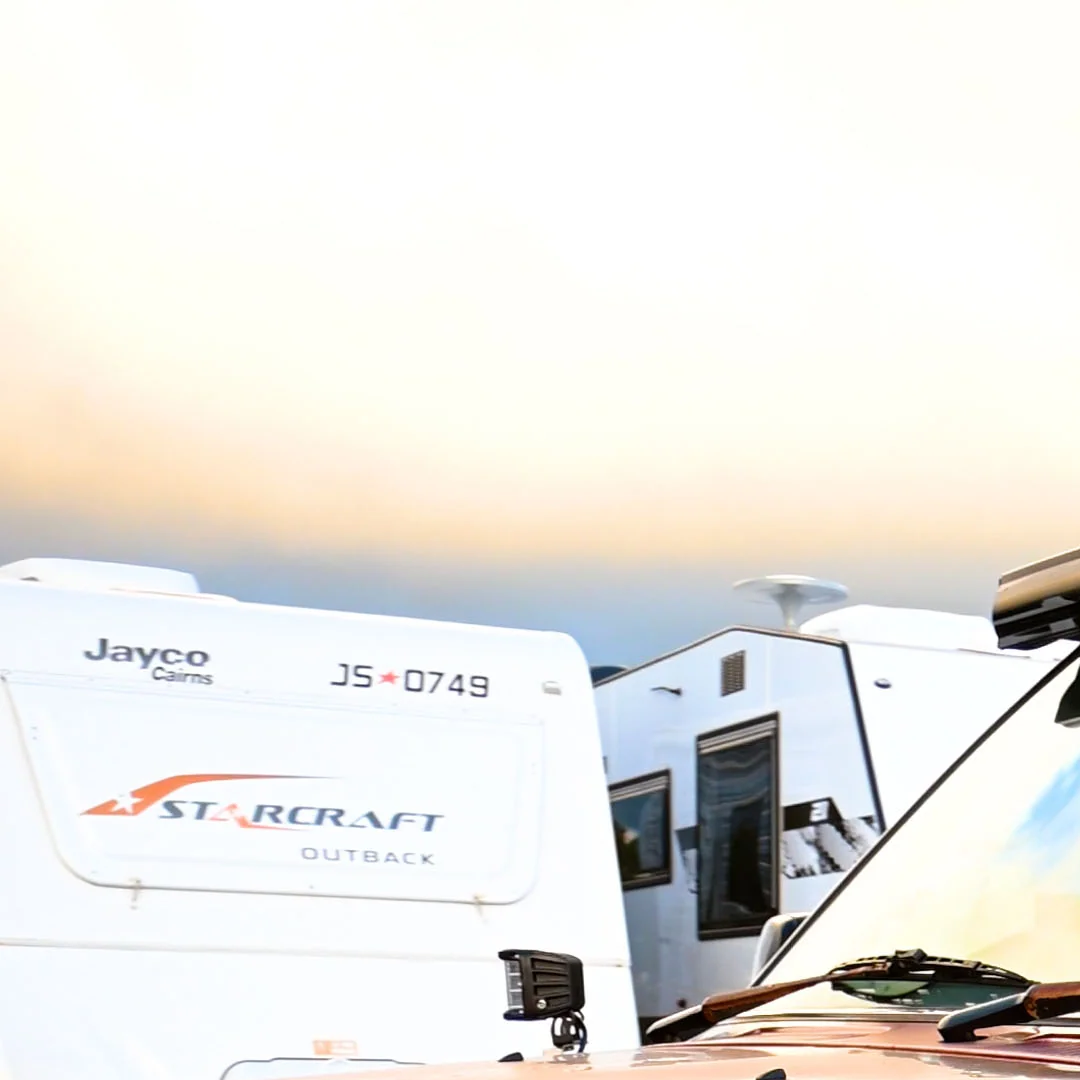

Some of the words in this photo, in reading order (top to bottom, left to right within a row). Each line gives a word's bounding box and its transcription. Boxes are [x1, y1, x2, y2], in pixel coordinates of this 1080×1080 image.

[83, 638, 210, 669] Jayco
[152, 666, 214, 685] Cairns
[157, 800, 445, 832] STARCRAFT
[300, 847, 435, 866] OUTBACK
